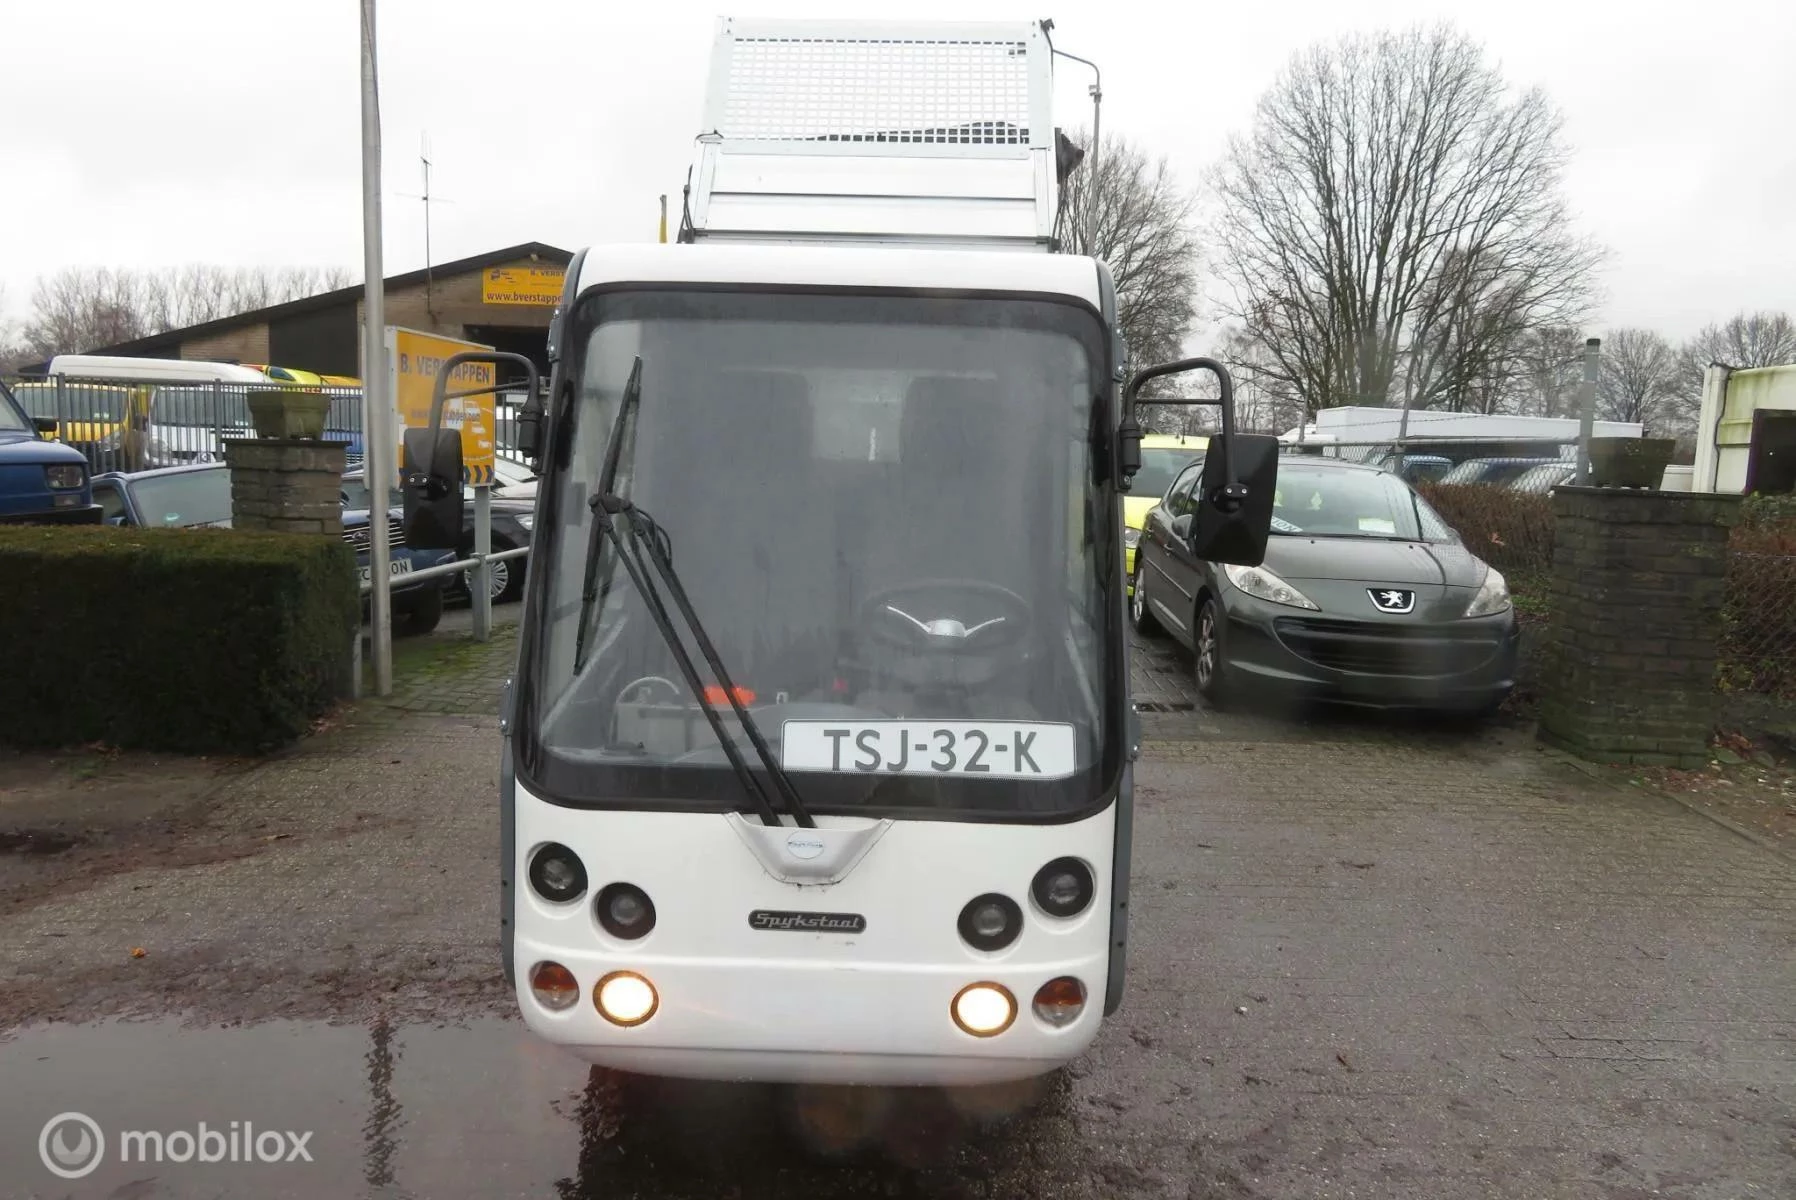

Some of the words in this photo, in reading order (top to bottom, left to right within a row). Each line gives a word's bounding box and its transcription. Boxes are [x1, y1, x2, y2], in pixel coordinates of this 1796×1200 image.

[416, 355, 490, 384] VERAPPEN
[823, 728, 1042, 773] TSJ-32-K
[753, 912, 860, 929] Spykstaal
